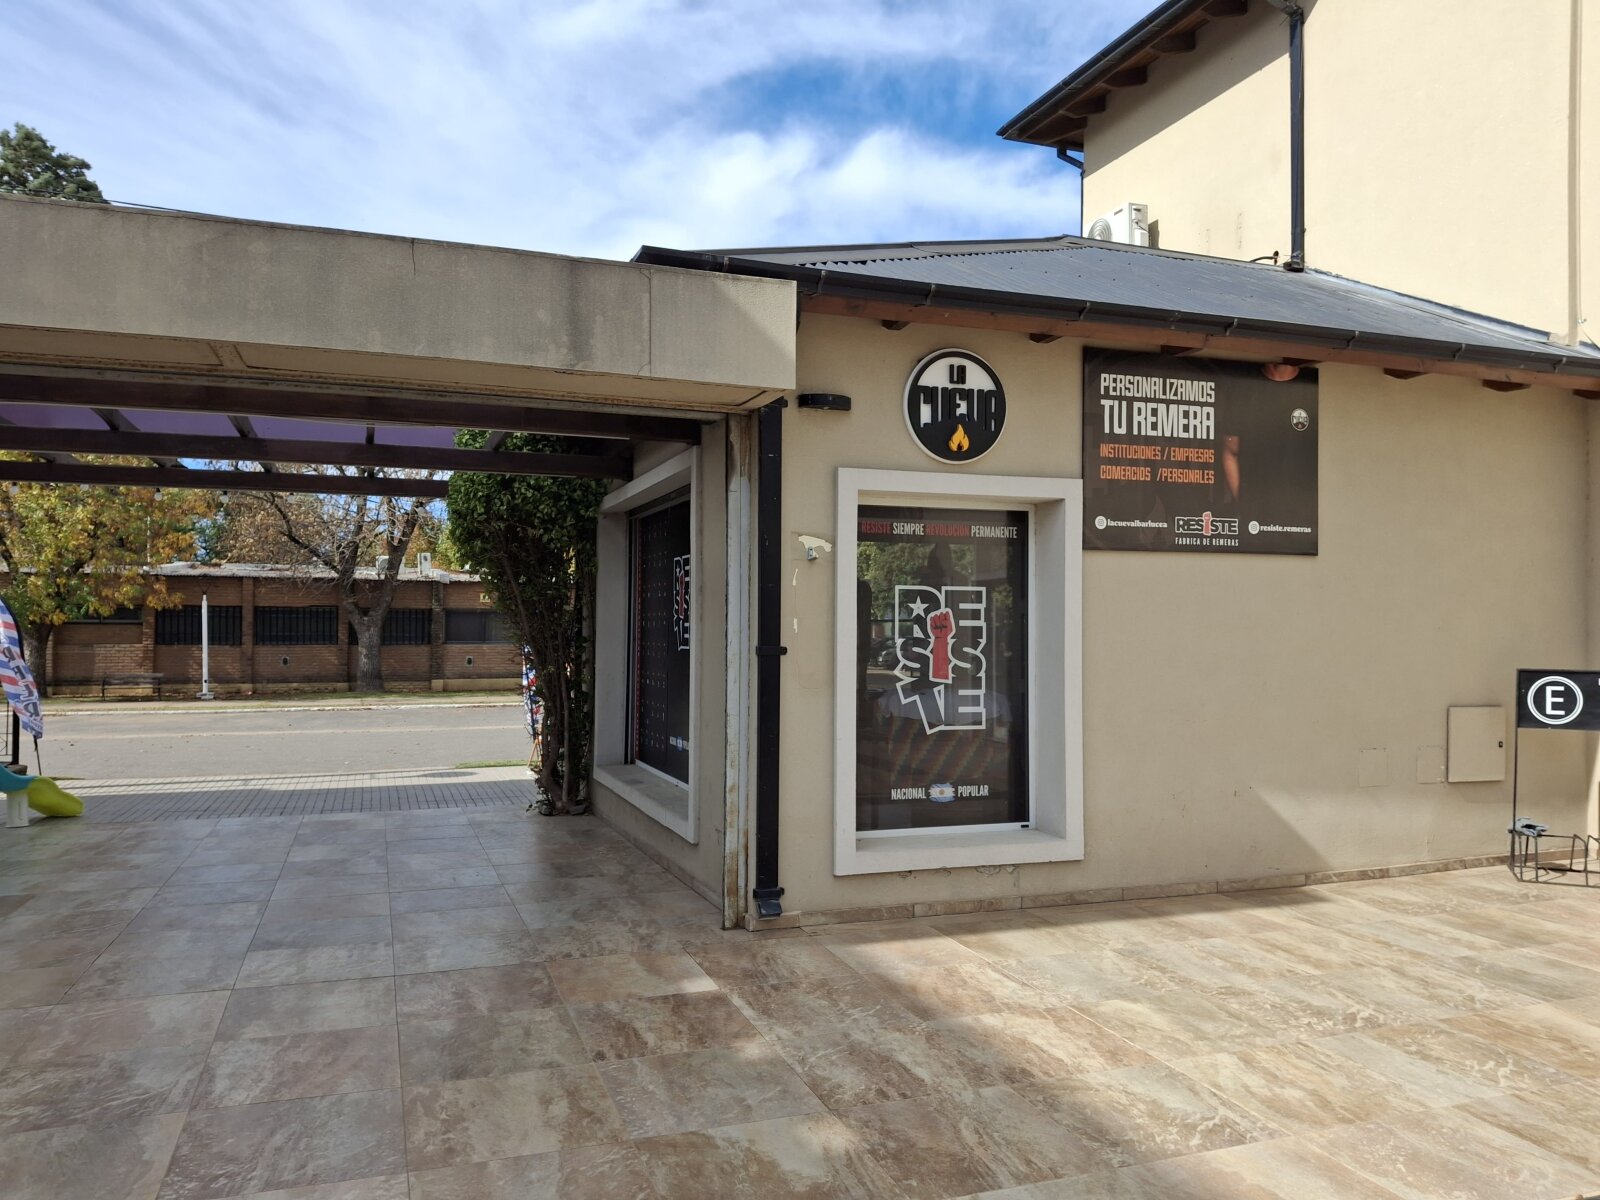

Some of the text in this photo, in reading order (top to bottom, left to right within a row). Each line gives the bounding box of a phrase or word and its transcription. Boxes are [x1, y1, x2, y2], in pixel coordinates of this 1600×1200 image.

[948, 364, 966, 385] LA
[1100, 373, 1215, 403] PERSONALIZAMOS
[1100, 399, 1215, 440] TU REMERA
[1100, 443, 1161, 460] INSTITUCIONES
[1170, 447, 1215, 463] EMPRESAS
[1100, 464, 1151, 481] COMERCIOS
[862, 521, 891, 534] RESISTE
[893, 522, 924, 536] SIEMPRE
[971, 525, 1018, 539] PERMANENTE
[1175, 537, 1239, 547] FABRICA DE REMERAS
[1545, 685, 1566, 716] E
[891, 785, 989, 800] NACIONAL POPULAR
